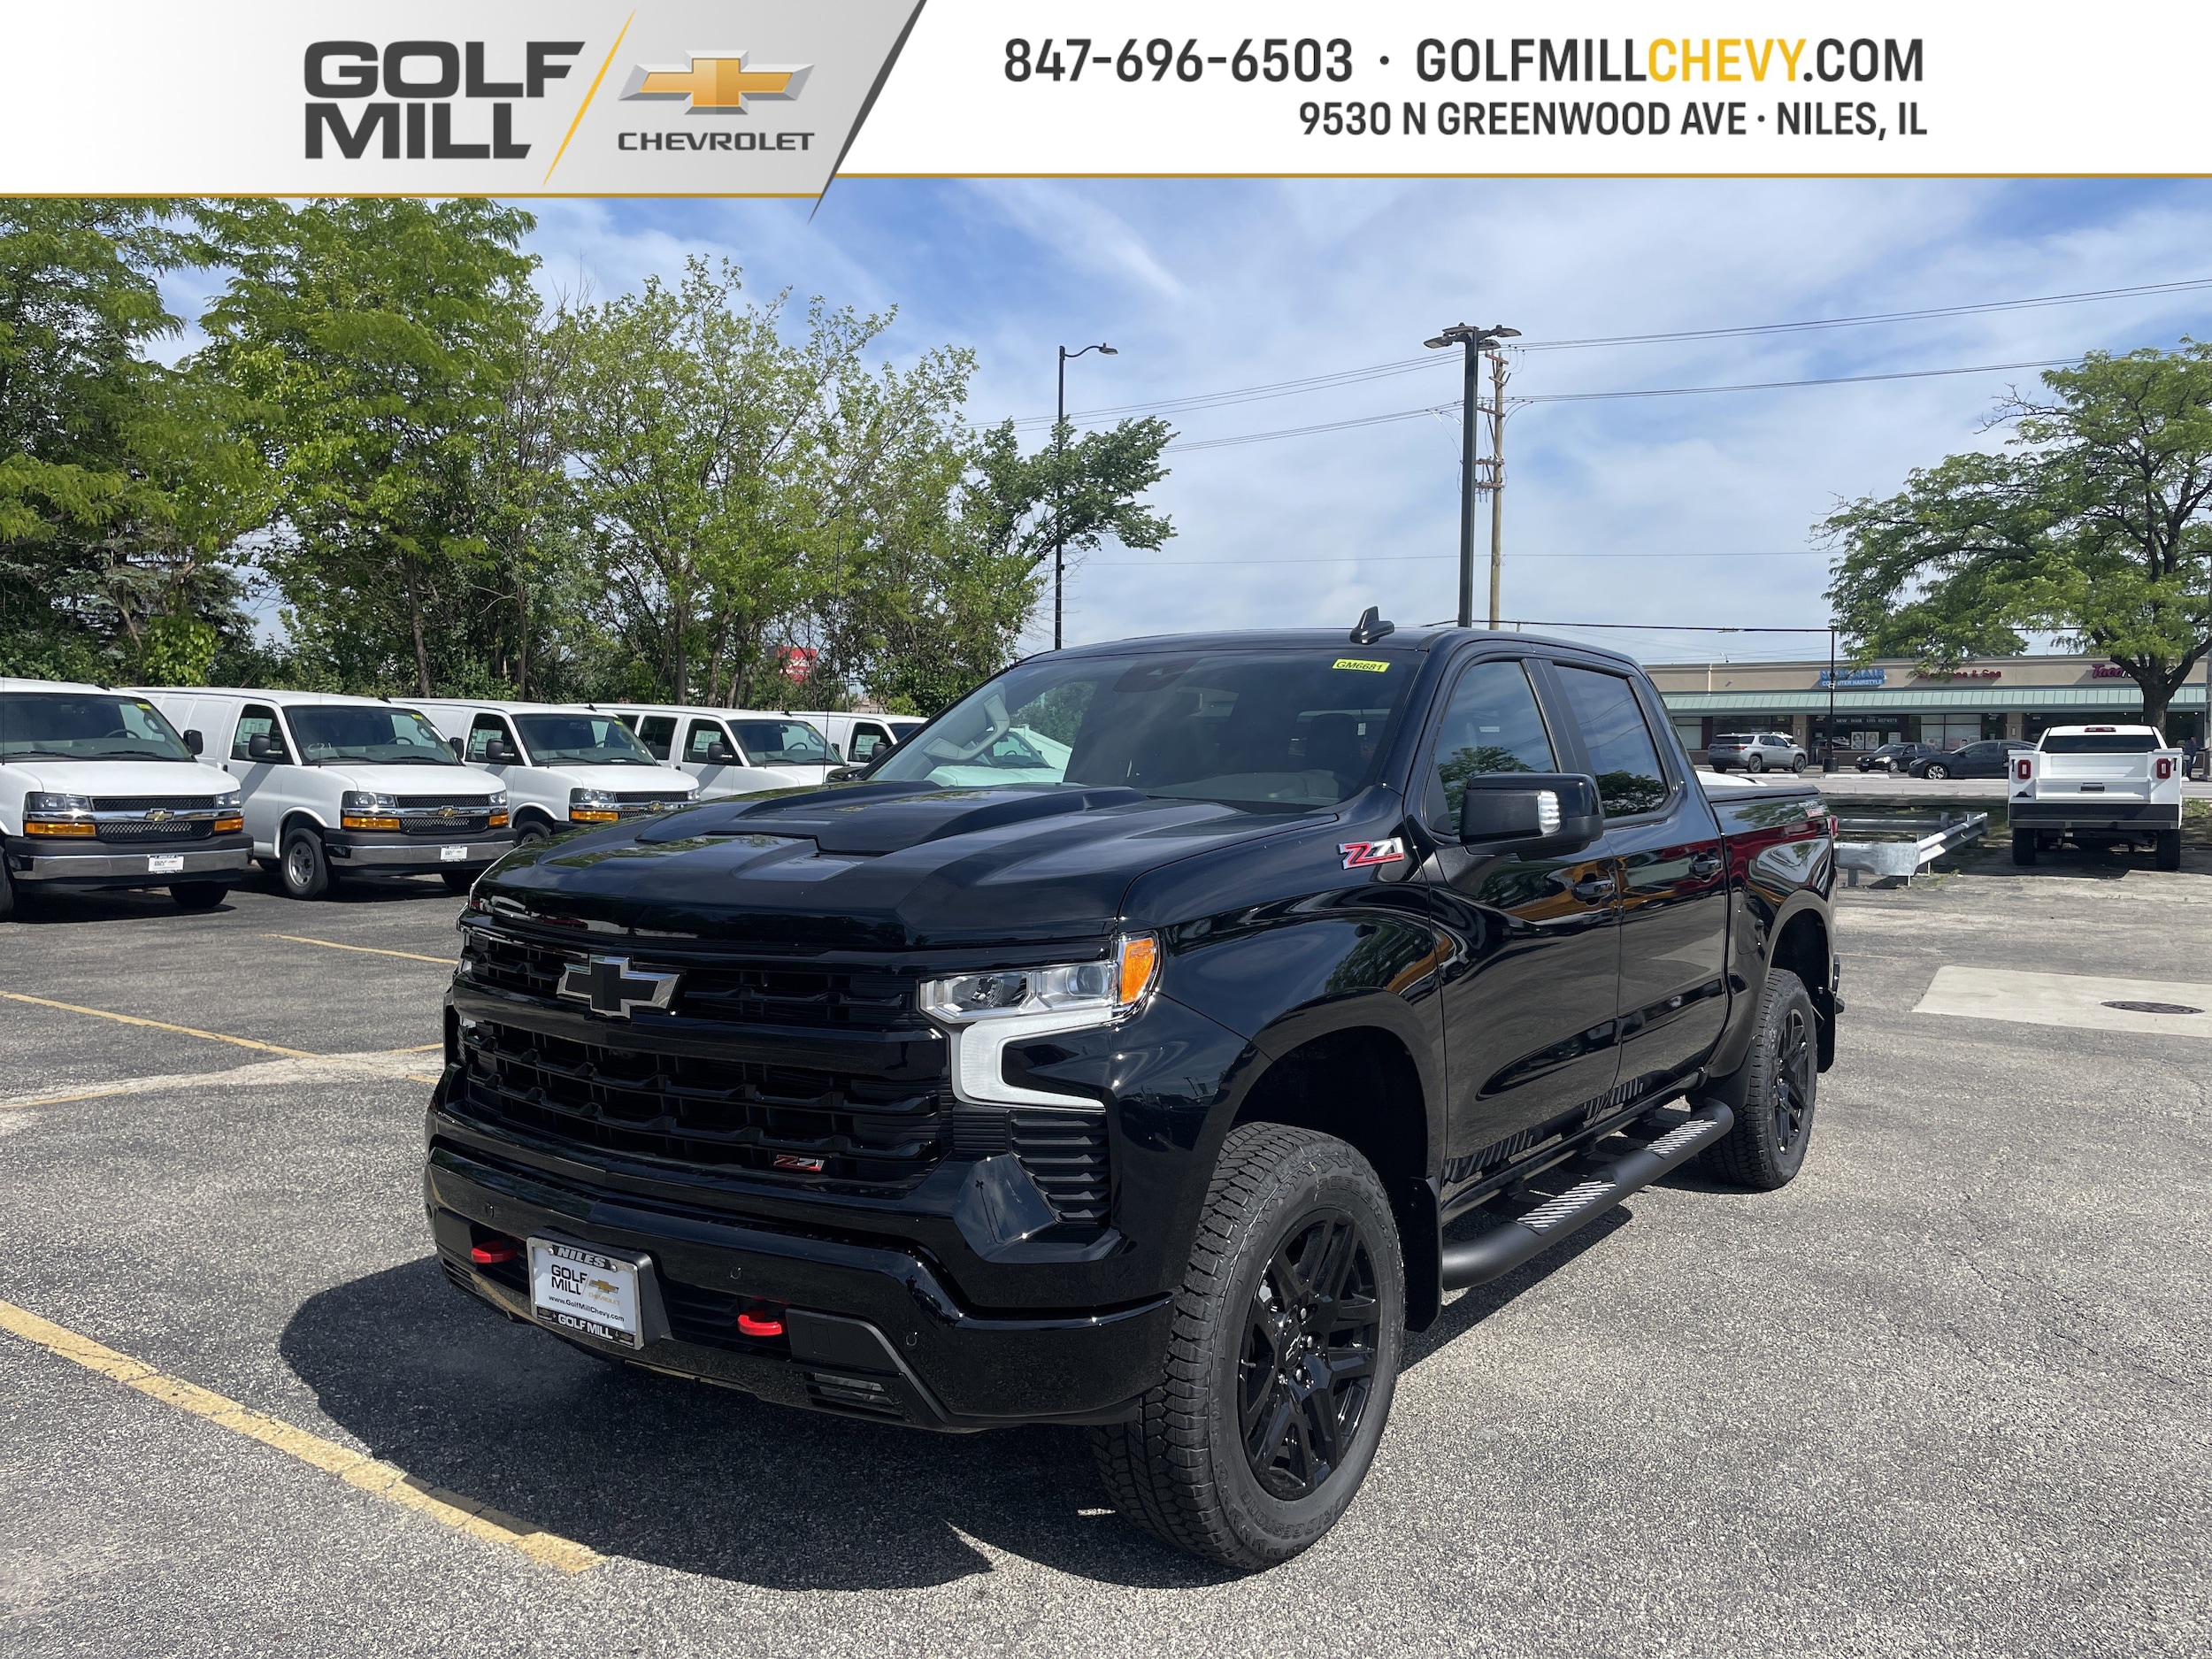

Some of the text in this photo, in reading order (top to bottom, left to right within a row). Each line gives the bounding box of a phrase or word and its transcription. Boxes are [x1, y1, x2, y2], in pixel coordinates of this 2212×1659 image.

[1336, 661, 1383, 671] GM6681
[1819, 670, 1848, 680] NW
[1339, 837, 1404, 870] Z71
[773, 1154, 825, 1171] Z71
[557, 1247, 606, 1268] NILES
[551, 1263, 588, 1284] GOLF
[551, 1276, 581, 1295] MILL
[549, 1295, 625, 1322] www.GolfMillChevy.com
[557, 1313, 613, 1340] GOLF MILL
